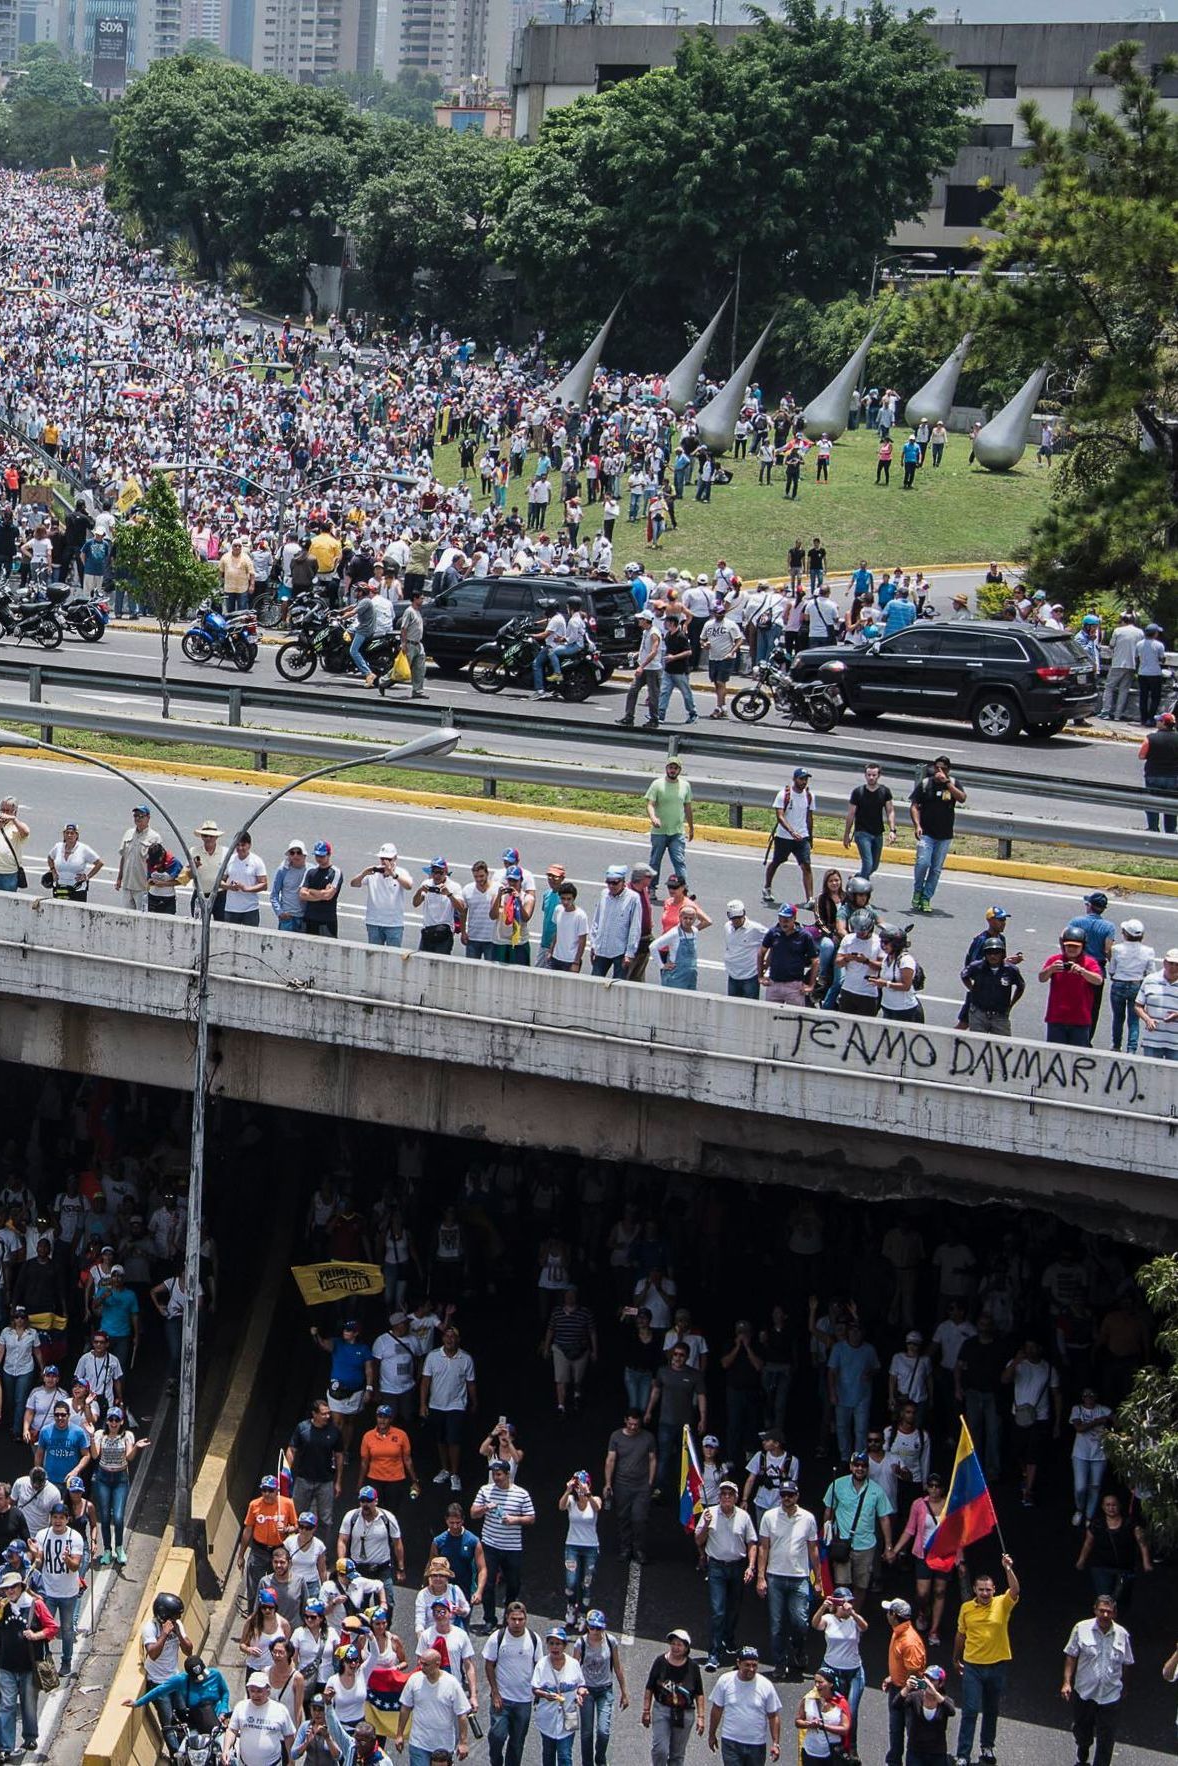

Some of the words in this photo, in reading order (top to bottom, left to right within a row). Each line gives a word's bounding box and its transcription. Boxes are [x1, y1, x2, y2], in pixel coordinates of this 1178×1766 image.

[99, 21, 124, 33] SOYA
[949, 1036, 1097, 1093] DAYMAR
[1104, 1060, 1146, 1104] M.
